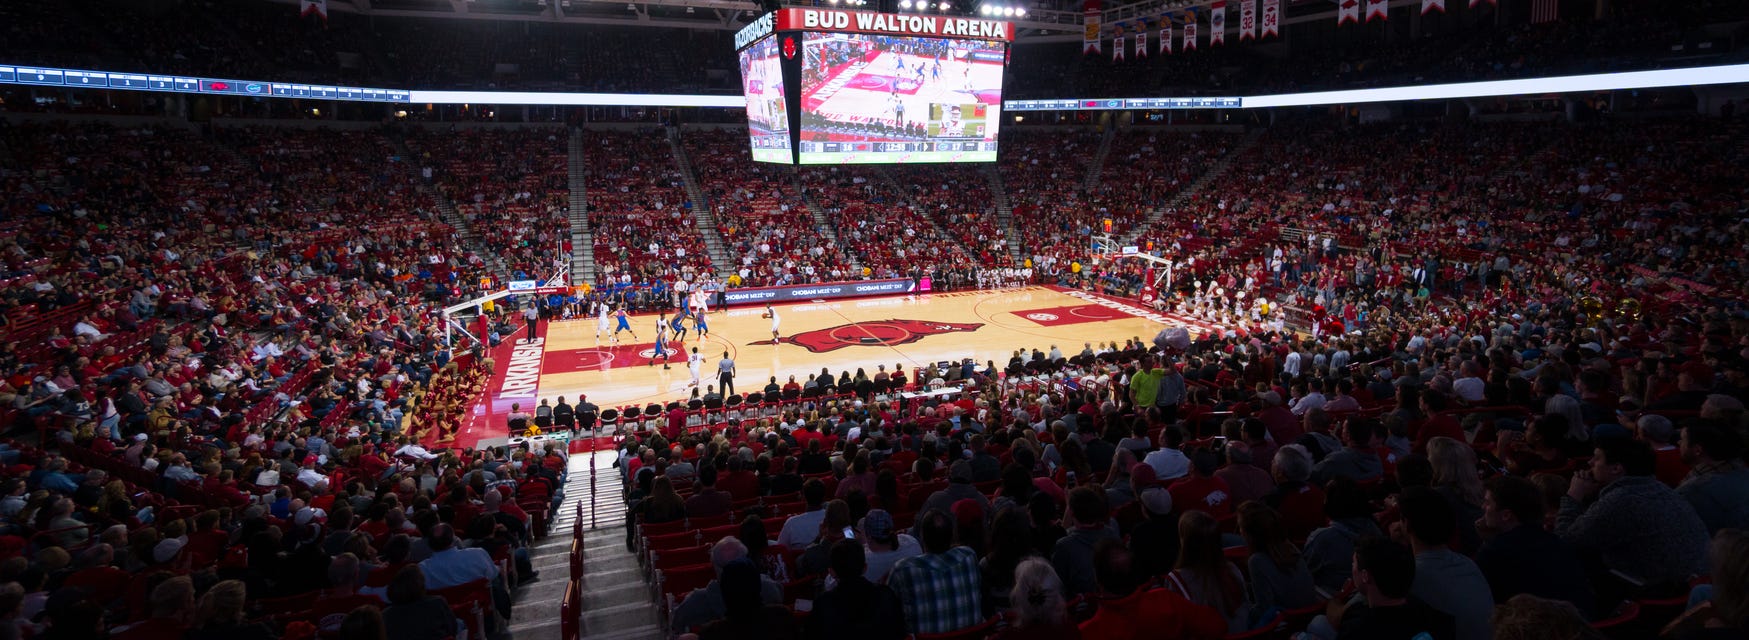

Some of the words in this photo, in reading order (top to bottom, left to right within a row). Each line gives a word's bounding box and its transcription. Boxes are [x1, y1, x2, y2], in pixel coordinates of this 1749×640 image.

[735, 11, 773, 51] RAZORBACKS
[804, 10, 849, 29] BUD
[856, 12, 937, 34] WALTON
[942, 18, 1006, 38] ARENA
[1242, 16, 1253, 30] 32
[1264, 13, 1276, 27] 34
[499, 336, 545, 399] ARKANSAS
